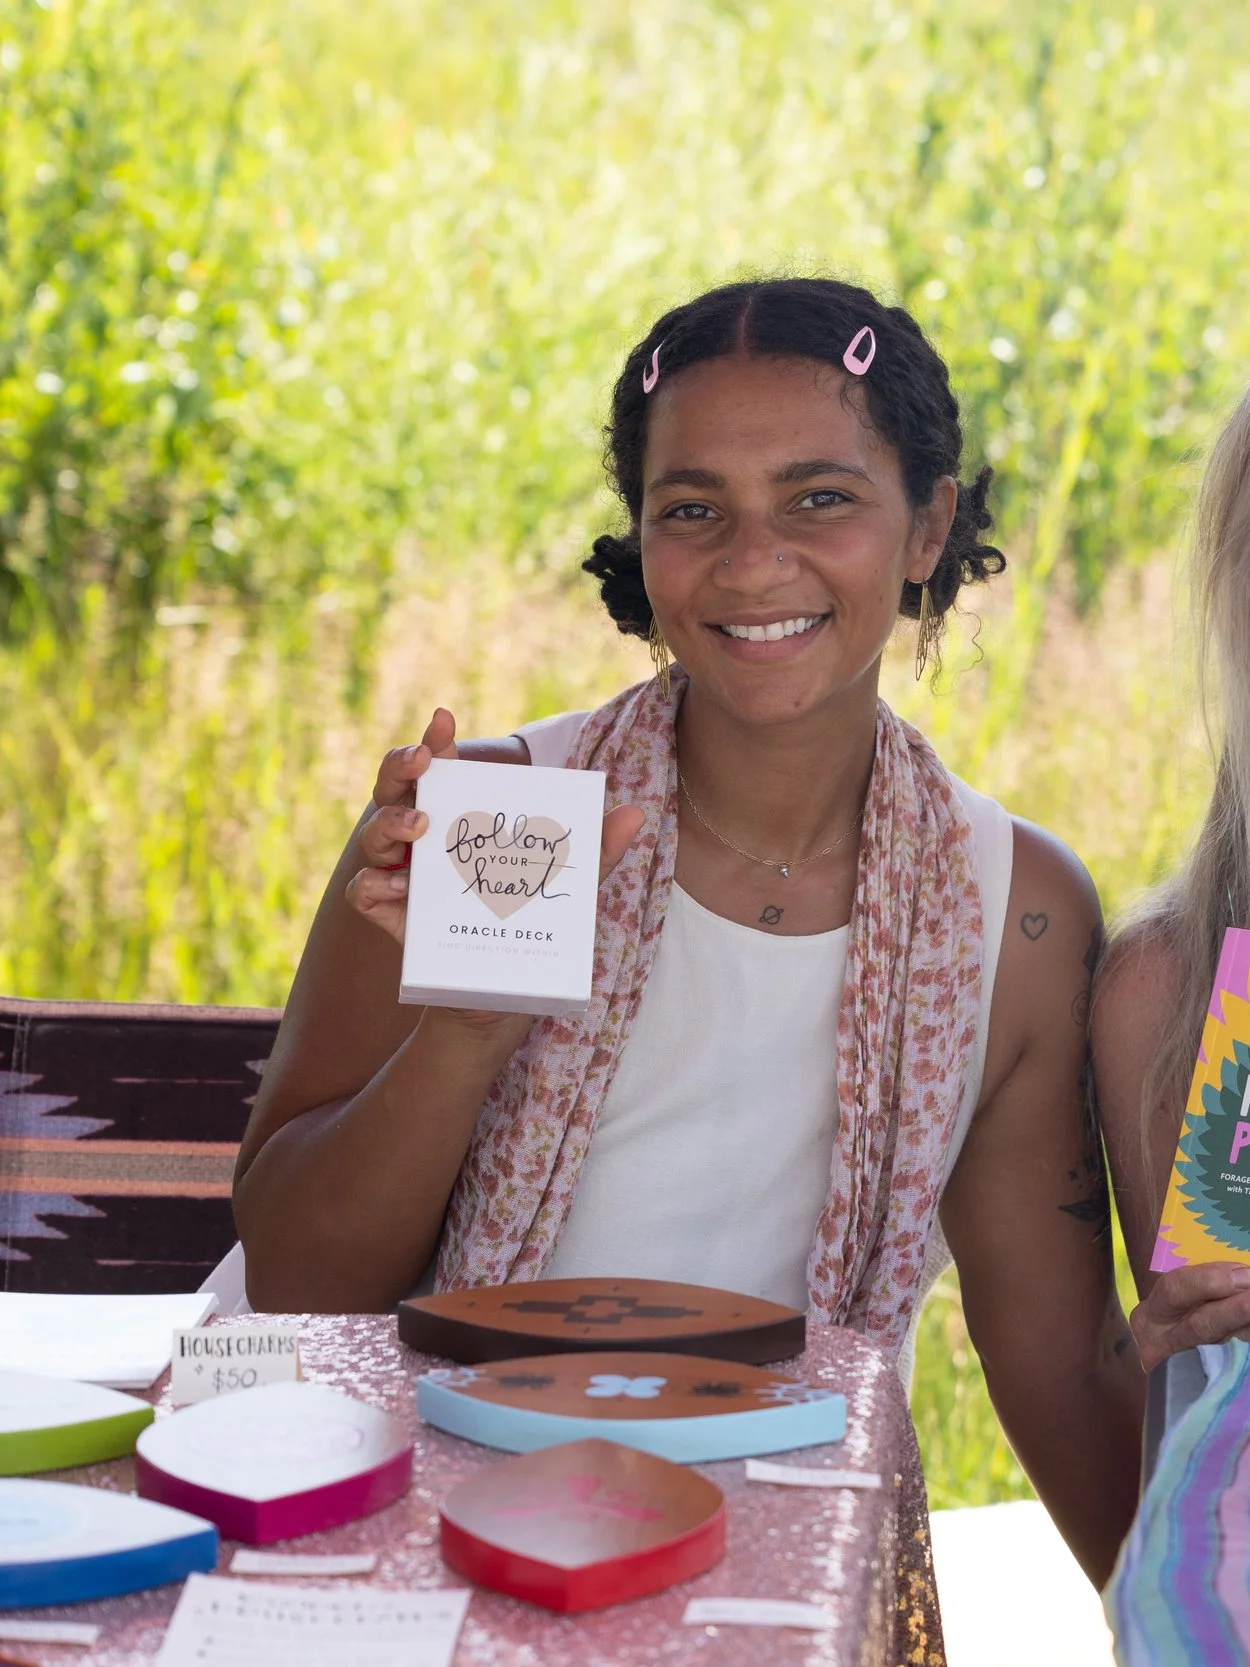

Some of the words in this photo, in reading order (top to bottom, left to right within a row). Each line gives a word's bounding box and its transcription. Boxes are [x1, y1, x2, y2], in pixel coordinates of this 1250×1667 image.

[446, 812, 572, 864] follow
[489, 855, 528, 867] YOUR
[461, 856, 574, 899] heart
[449, 924, 507, 938] ORACLE
[515, 929, 553, 942] DECK
[1226, 1185, 1243, 1194] with
[212, 1367, 258, 1394] $50
